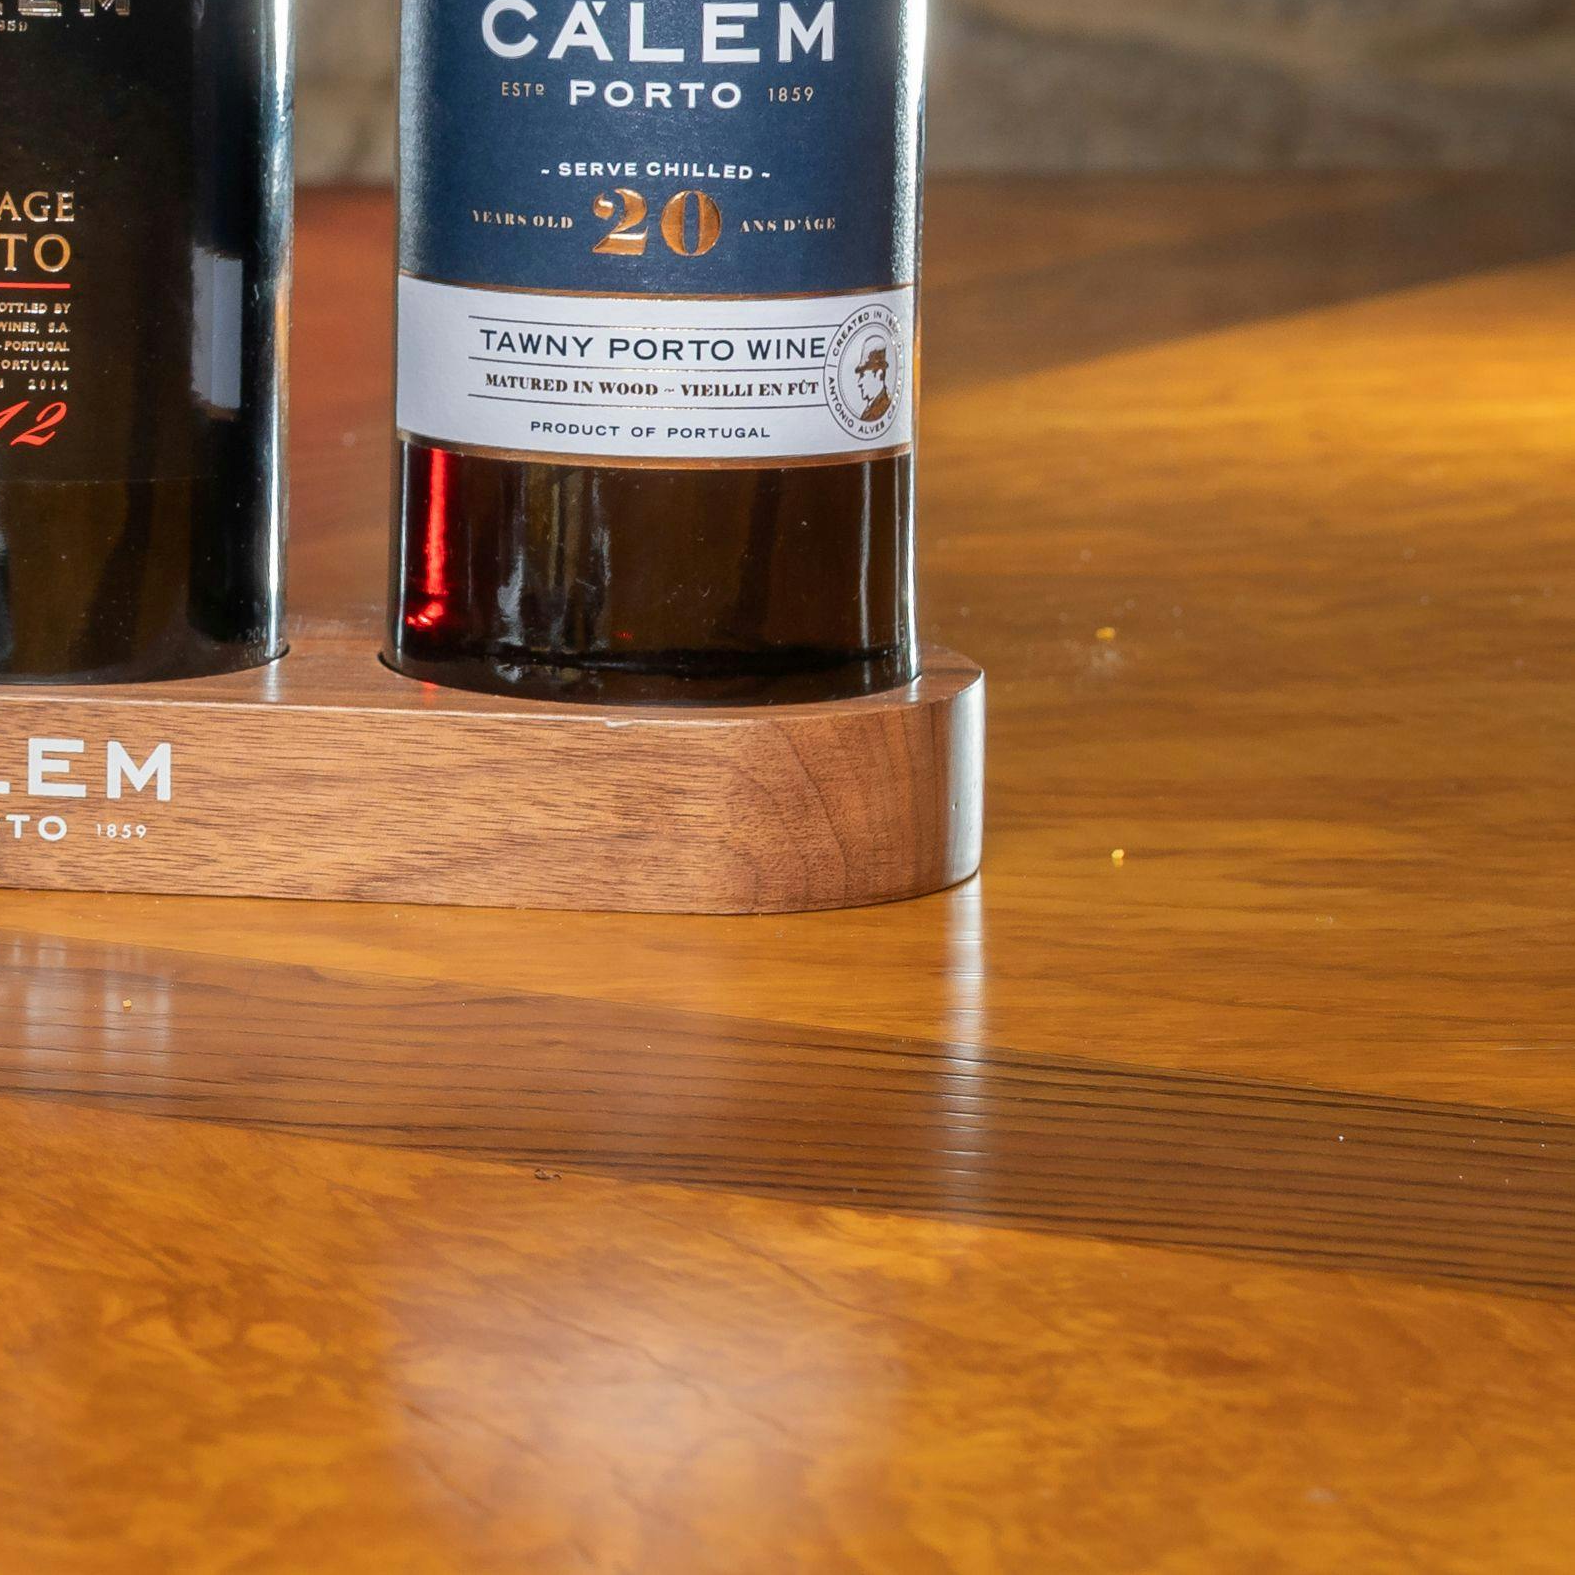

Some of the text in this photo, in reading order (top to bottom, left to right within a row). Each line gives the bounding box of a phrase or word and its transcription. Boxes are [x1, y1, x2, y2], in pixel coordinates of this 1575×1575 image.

[568, 79, 742, 110] PORTO
[767, 85, 815, 103] 1859
[558, 161, 638, 177] SERVE
[646, 161, 754, 180] CHILLED
[471, 209, 528, 226] YEARS
[532, 214, 574, 230] OLD
[591, 187, 723, 258] 20
[739, 218, 778, 233] ANS
[53, 303, 72, 314] BY
[480, 328, 826, 362] TAWNY PORTO WINE
[833, 311, 870, 357] CREATED
[873, 310, 883, 320] IN
[4, 340, 71, 353] PORTUGAL
[27, 378, 69, 391] 2014
[484, 372, 569, 393] MATURED
[574, 380, 594, 395] IN
[599, 381, 659, 397] WOOD
[681, 382, 753, 398] VIEILLI
[759, 383, 783, 397] EN
[788, 378, 819, 396] FÛT
[827, 376, 855, 429] ANTÓNIO
[857, 420, 886, 435] ALVES
[531, 420, 771, 440] PRODUCT OF PORTUGAL
[97, 823, 148, 840] 1859
